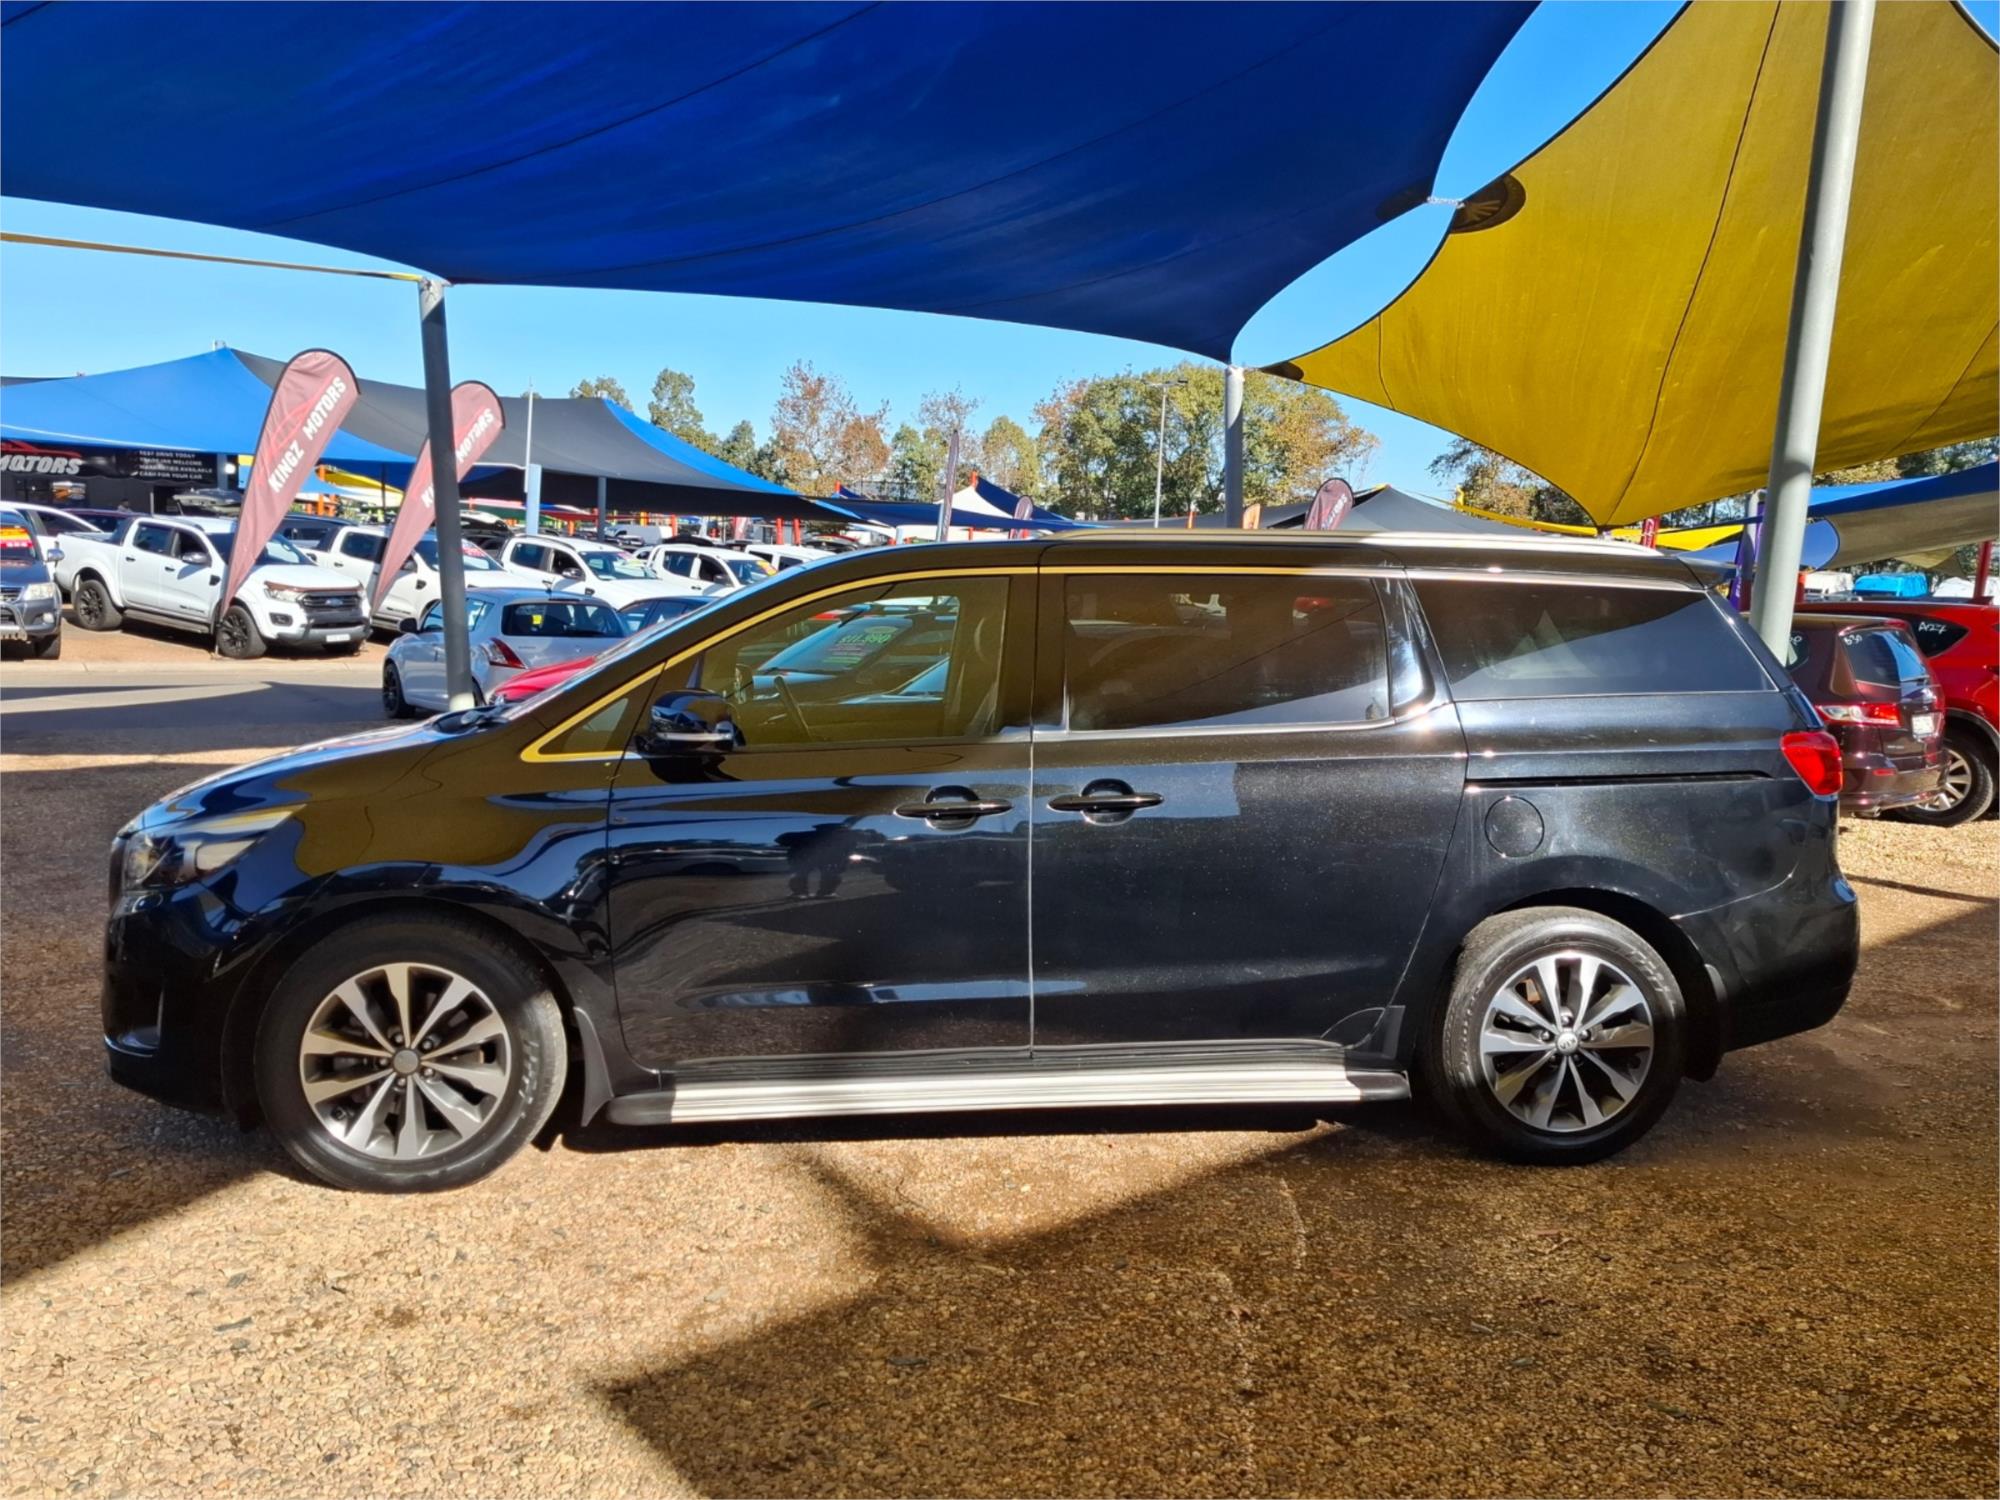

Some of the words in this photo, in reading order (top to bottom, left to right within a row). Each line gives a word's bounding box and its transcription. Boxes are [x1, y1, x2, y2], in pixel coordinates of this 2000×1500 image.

[268, 440, 304, 493] KINGZ
[302, 377, 346, 440] MOTORS
[456, 408, 494, 463] MOTORS
